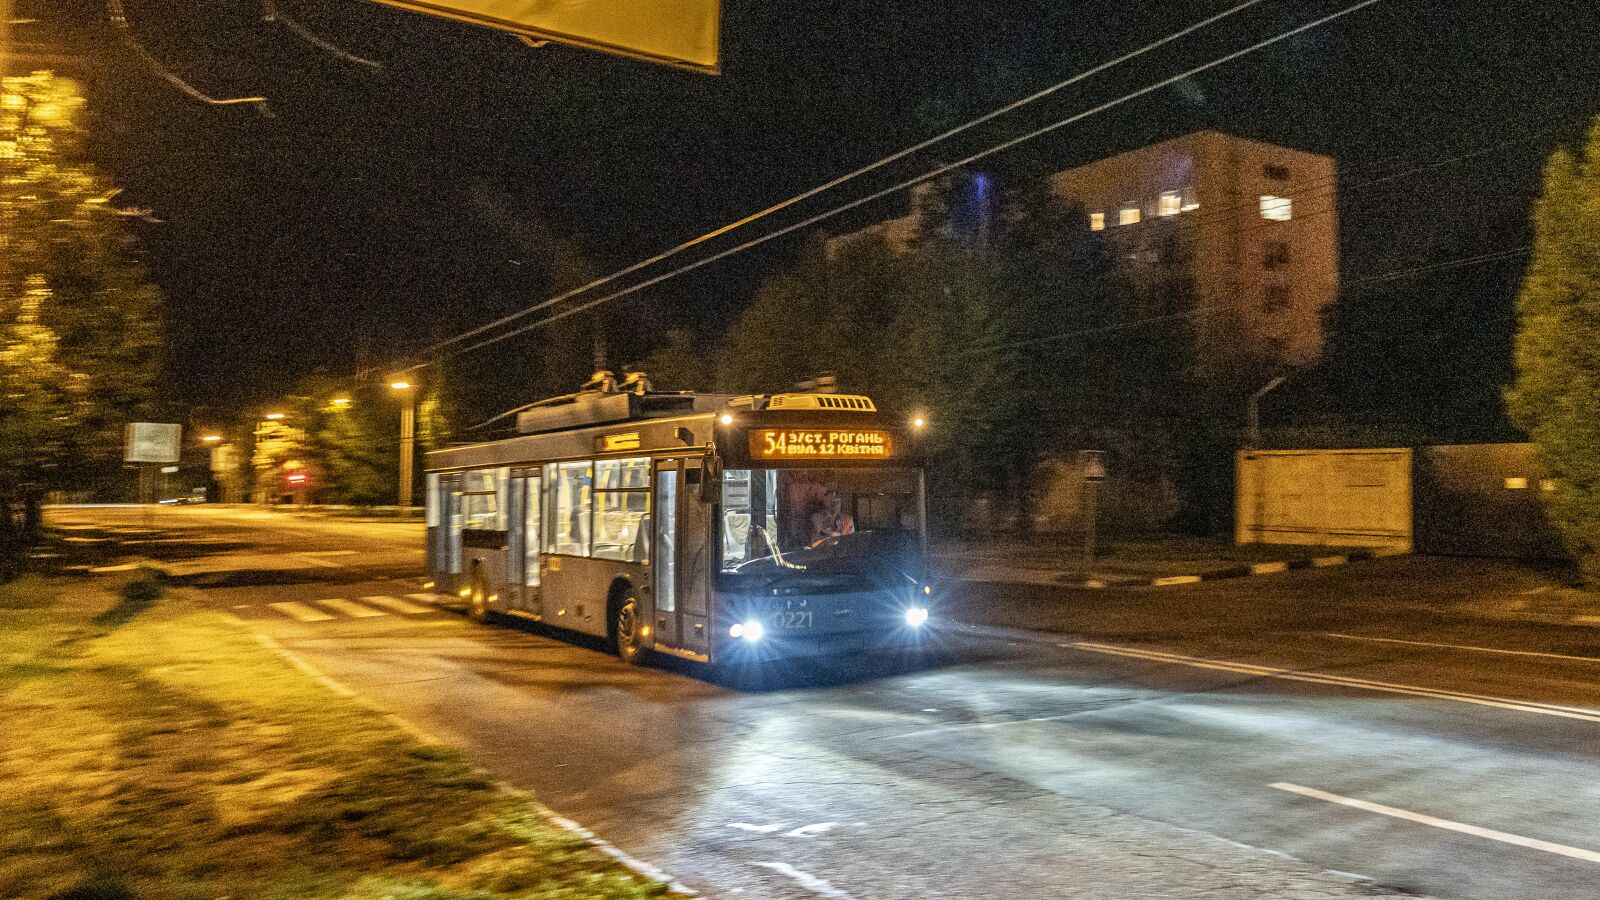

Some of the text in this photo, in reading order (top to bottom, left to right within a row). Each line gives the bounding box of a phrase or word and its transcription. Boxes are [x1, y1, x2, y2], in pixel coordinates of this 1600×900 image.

[765, 432, 786, 454] 54
[830, 432, 883, 444] РОГАНЬ
[819, 444, 835, 454] 12
[774, 612, 813, 628] 0221
